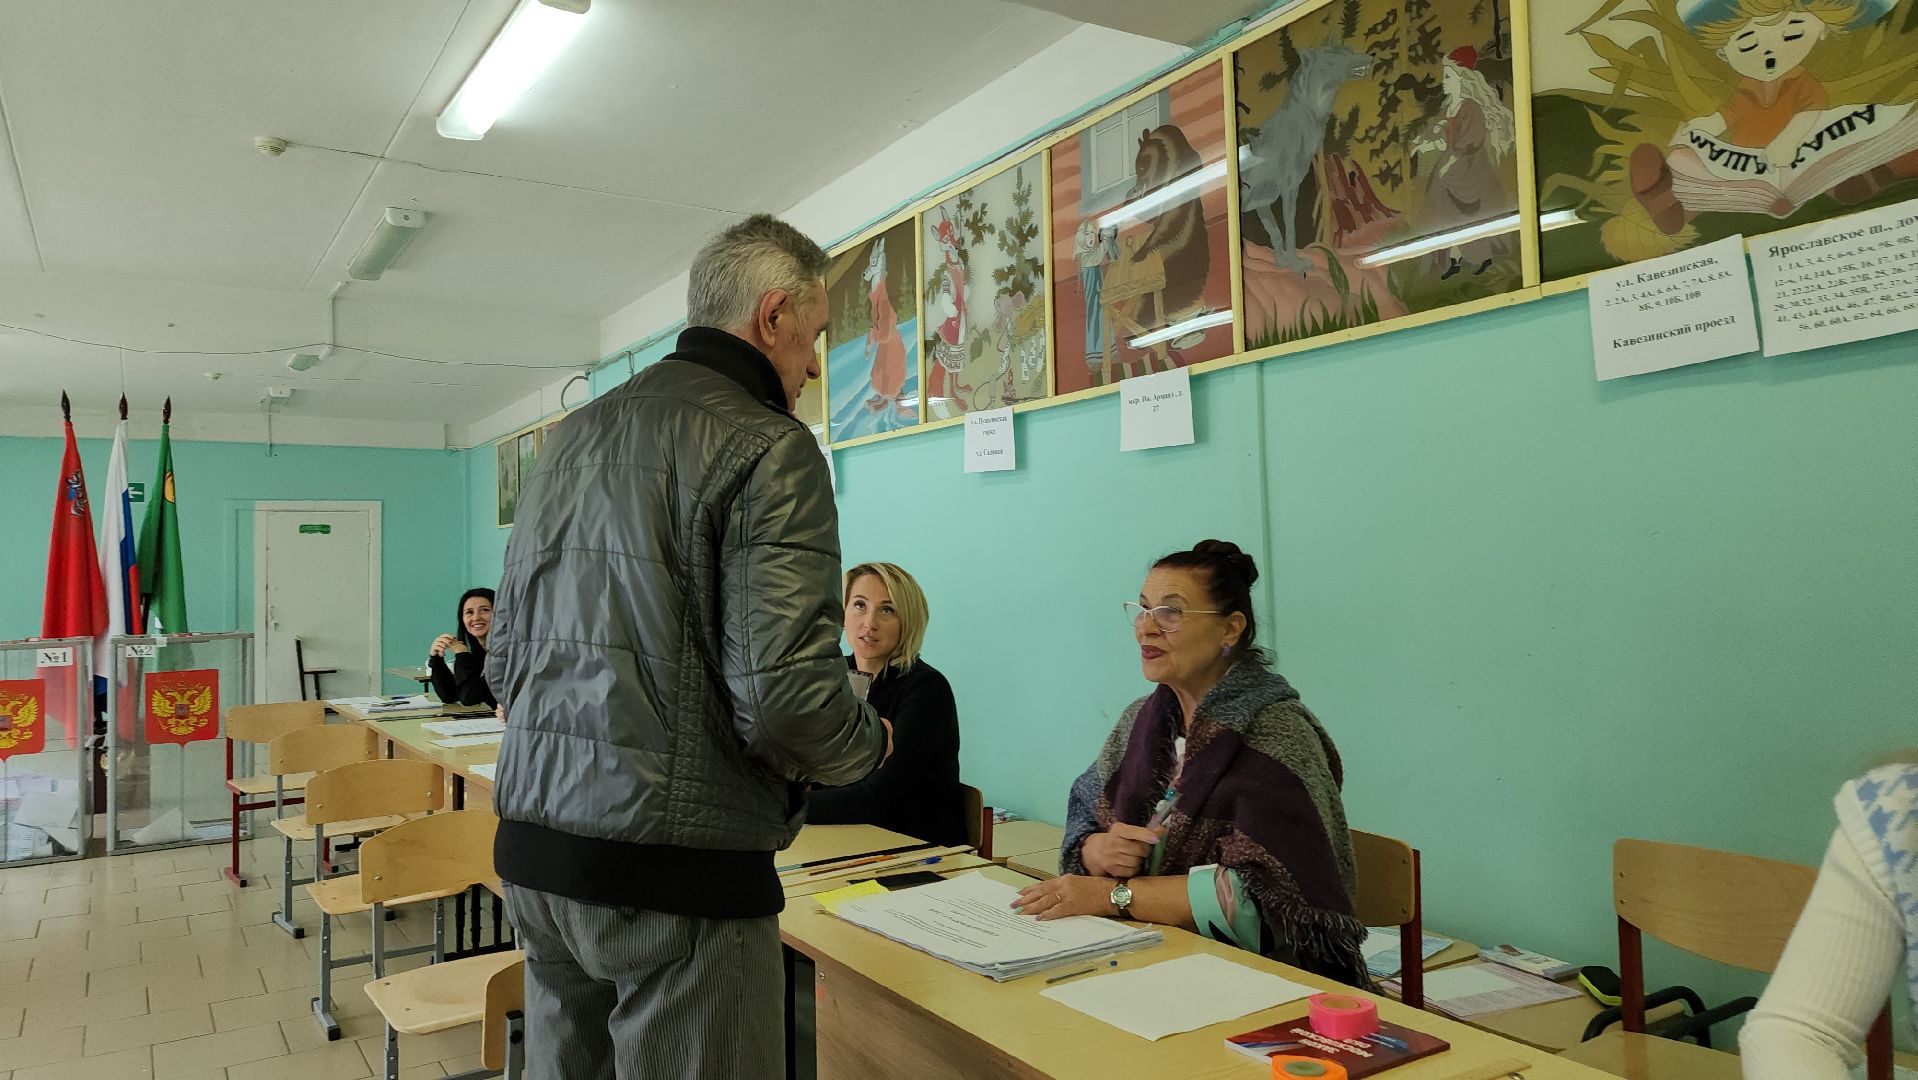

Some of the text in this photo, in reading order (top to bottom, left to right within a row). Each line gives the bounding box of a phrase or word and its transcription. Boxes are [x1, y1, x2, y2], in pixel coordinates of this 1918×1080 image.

[1768, 228, 1865, 258] Ярославское
[1613, 315, 1737, 349] Кавезинский проезд
[40, 651, 68, 664] №1
